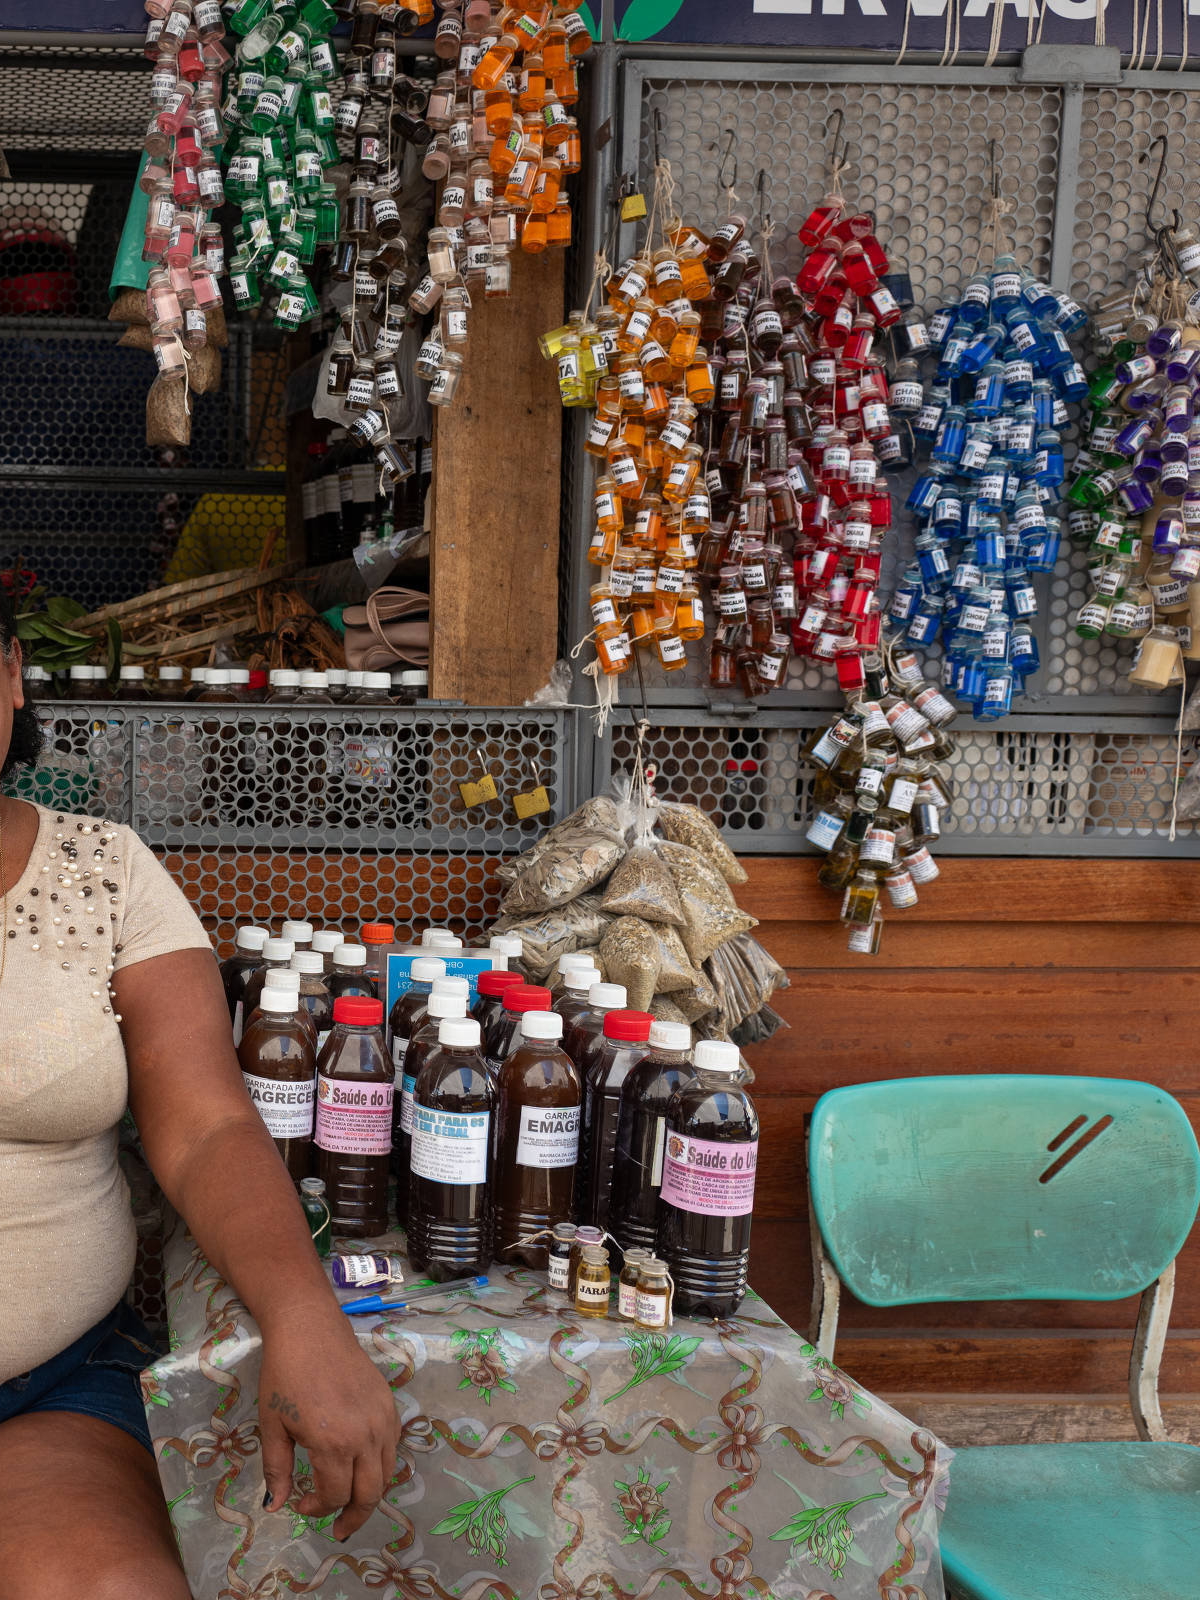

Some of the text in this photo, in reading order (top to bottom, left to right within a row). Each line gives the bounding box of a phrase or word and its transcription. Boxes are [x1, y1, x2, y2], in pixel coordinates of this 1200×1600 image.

[333, 1087, 383, 1105] Saúde do
[688, 1146, 727, 1169] Saúde
[731, 1152, 743, 1170] do
